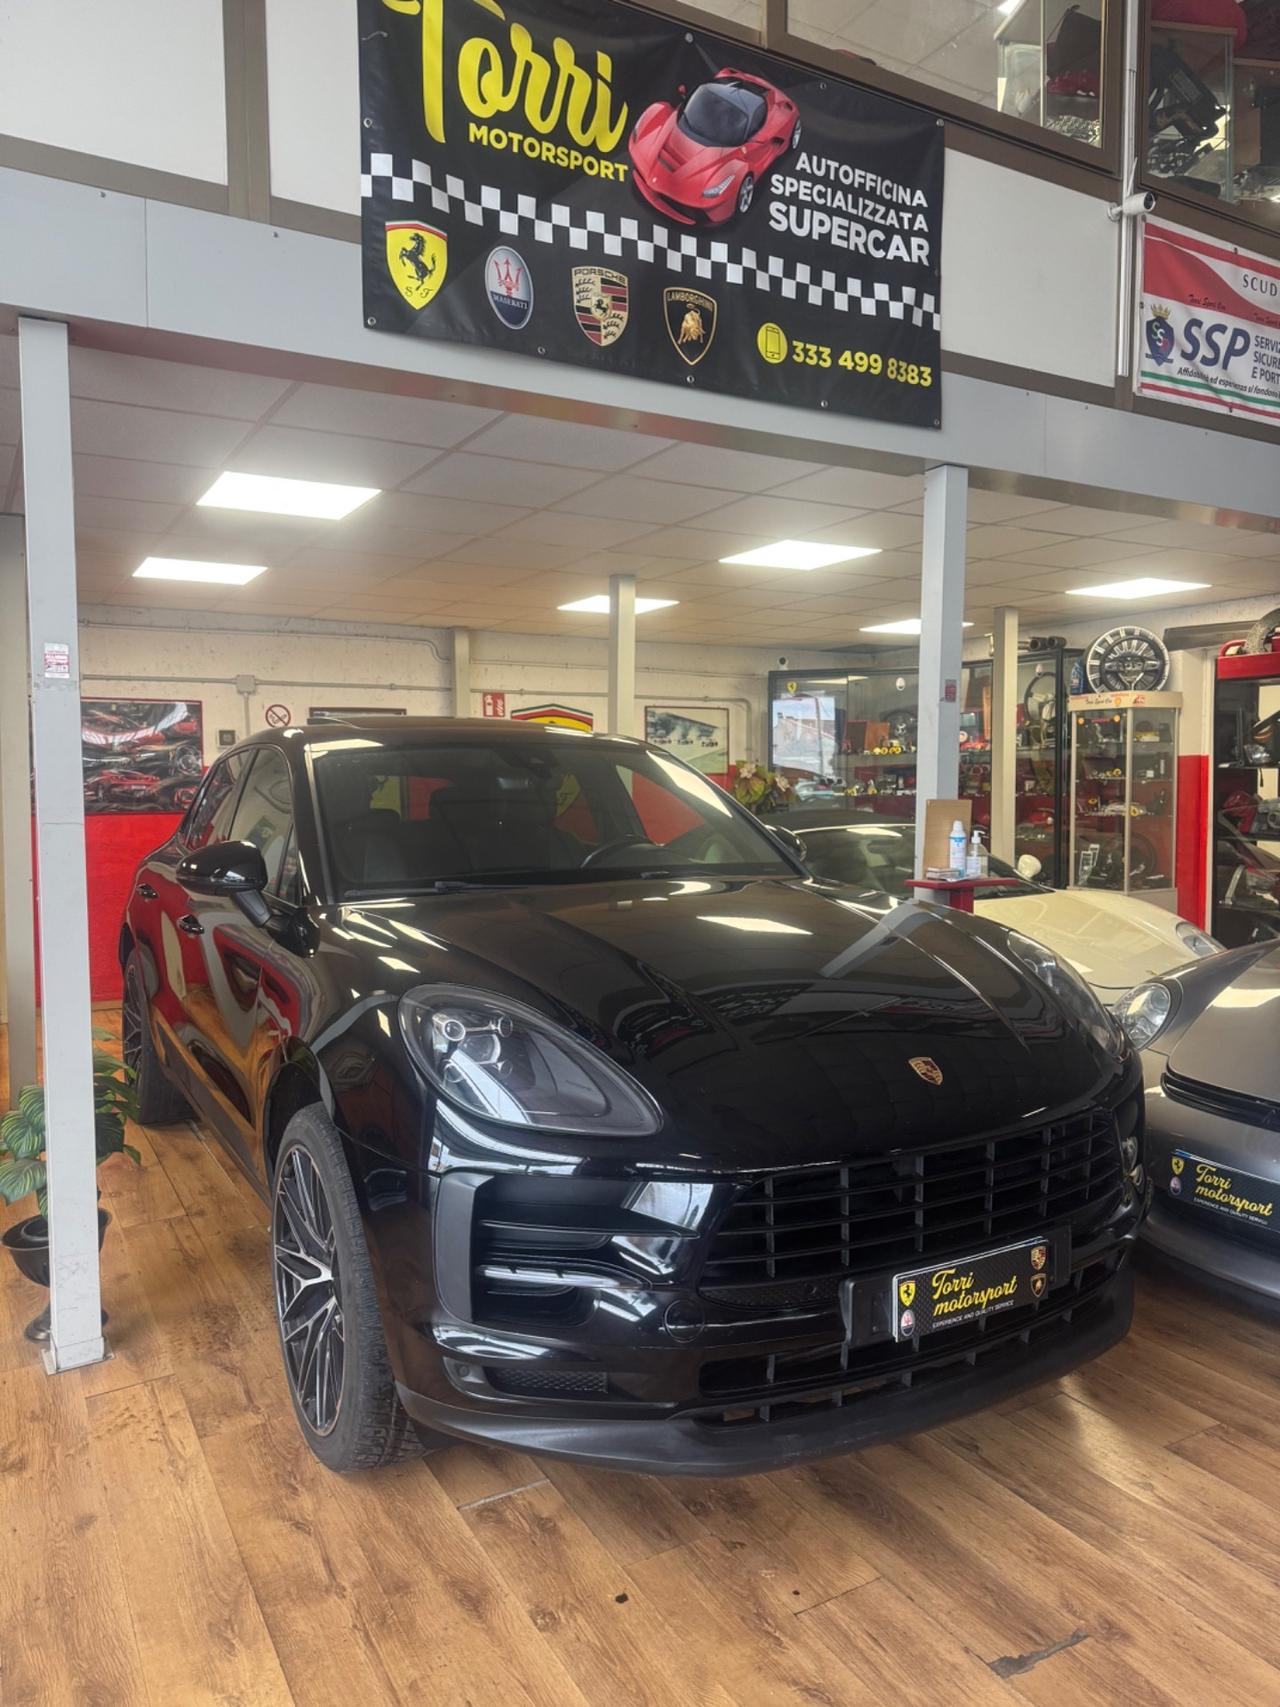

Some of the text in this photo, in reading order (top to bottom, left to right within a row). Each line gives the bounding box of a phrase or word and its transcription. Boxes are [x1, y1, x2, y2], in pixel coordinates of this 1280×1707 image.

[468, 122, 629, 182] MOTORSPORT
[795, 151, 928, 208] AUTOFFICINA
[770, 173, 929, 232] SPECIALIZZATA
[768, 201, 931, 266] SUPERCAR
[574, 267, 627, 284] PORSCHE
[1242, 273, 1278, 297] SCUD
[792, 339, 932, 387] 333 499 8383
[1180, 317, 1251, 371] SSP
[1251, 366, 1259, 379] E
[1195, 1163, 1232, 1190] Torri
[1194, 1185, 1273, 1217] motorsport
[931, 1267, 975, 1300] Torri
[932, 1275, 1018, 1317] motorsport
